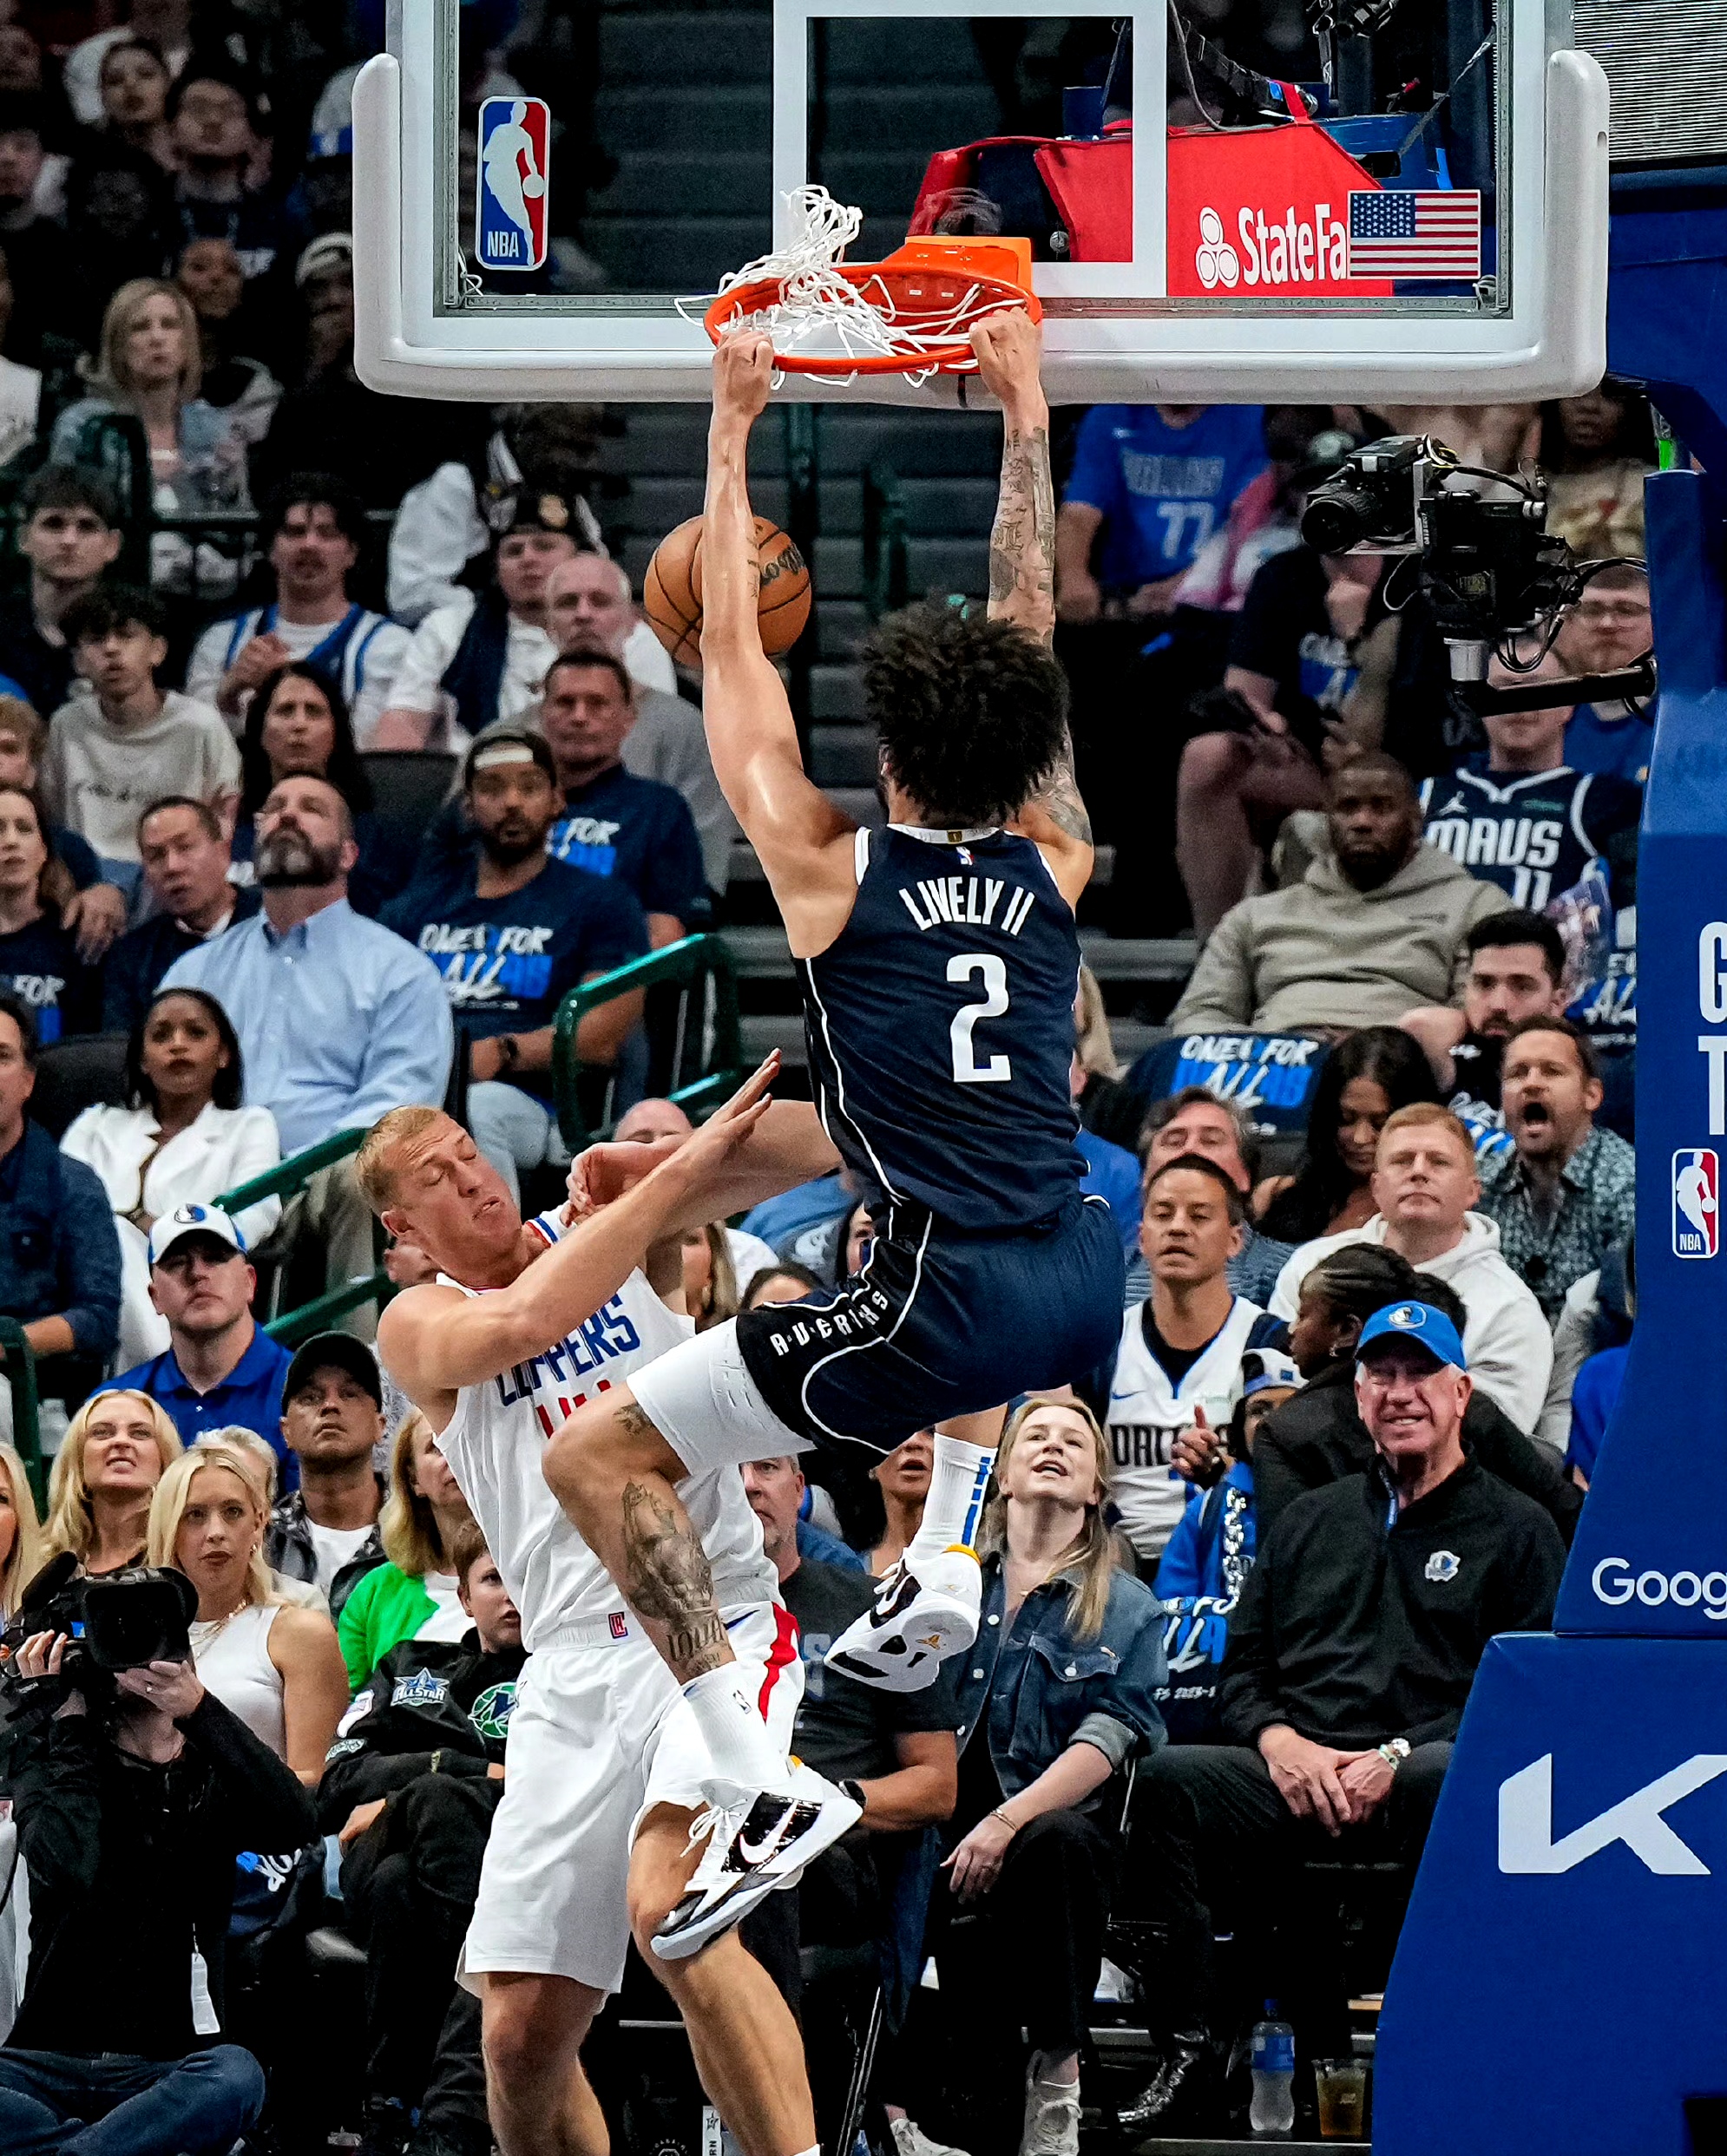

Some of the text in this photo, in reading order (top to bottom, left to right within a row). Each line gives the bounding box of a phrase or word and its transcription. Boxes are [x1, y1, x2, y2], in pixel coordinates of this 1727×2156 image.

[488, 231, 519, 258] NBA
[1156, 501, 1215, 560] 77
[1425, 817, 1563, 868] MAVS
[898, 876, 1035, 936] LIVELY II
[946, 953, 1012, 1083] 2
[1679, 1234, 1702, 1251] NBA
[494, 1294, 640, 1406] CLPPERS
[1592, 1557, 1727, 1620] Goog
